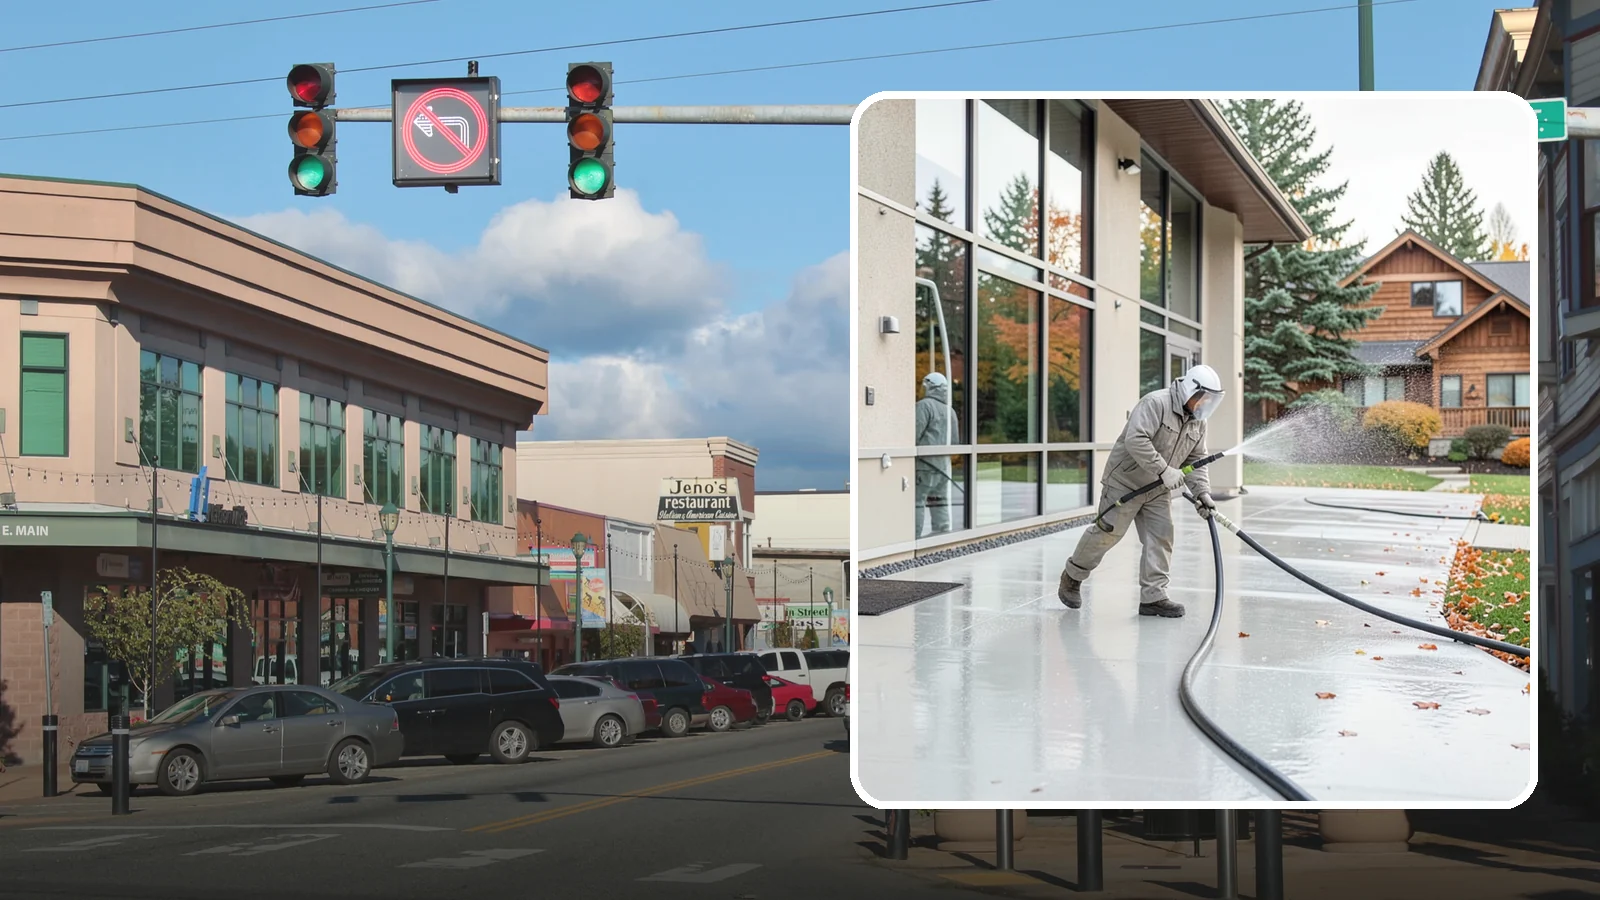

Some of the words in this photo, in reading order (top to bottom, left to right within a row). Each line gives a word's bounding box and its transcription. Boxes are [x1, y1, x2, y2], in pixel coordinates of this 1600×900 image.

[670, 480, 728, 495] Jeno's
[665, 496, 731, 509] restaurant
[658, 509, 682, 520] Italian
[686, 509, 714, 520] American
[715, 509, 738, 519] Cuisine
[2, 525, 13, 536] E.
[15, 525, 49, 536] MAIN
[797, 607, 828, 617] Street
